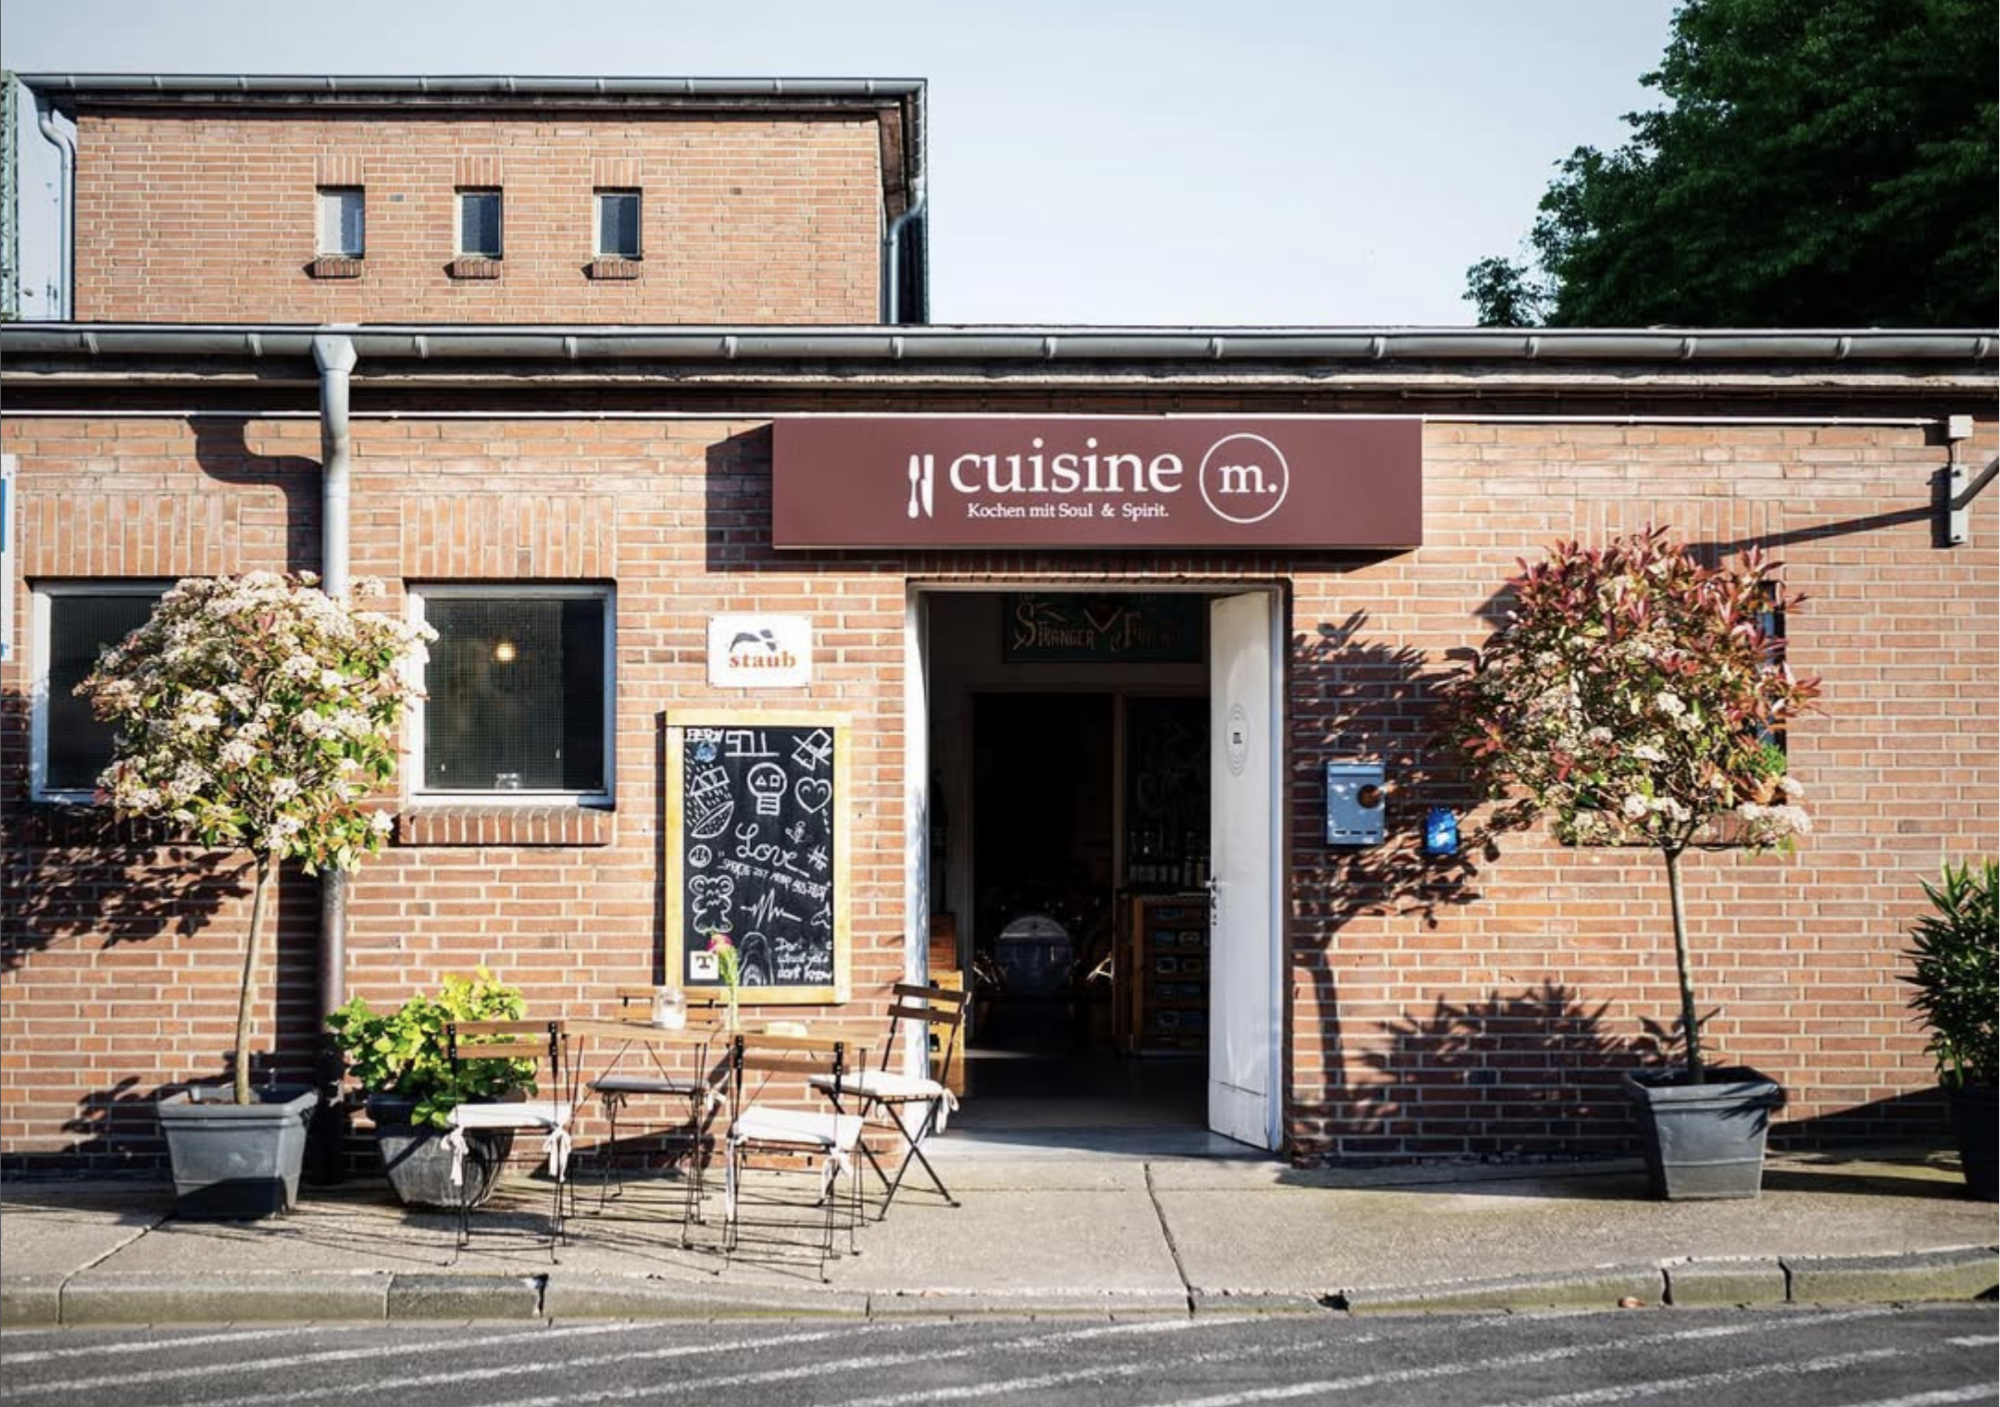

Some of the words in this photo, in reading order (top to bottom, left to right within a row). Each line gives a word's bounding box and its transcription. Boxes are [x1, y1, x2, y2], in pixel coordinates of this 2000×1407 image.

[949, 437, 1183, 494] cuisine
[1218, 462, 1279, 494] m.
[967, 503, 1026, 518] Kochen
[1029, 503, 1056, 518] mit
[1058, 503, 1093, 518] Soul
[1101, 504, 1116, 518] &
[1122, 503, 1169, 522] Spirit.
[728, 650, 797, 668] staub
[735, 823, 810, 878] Love
